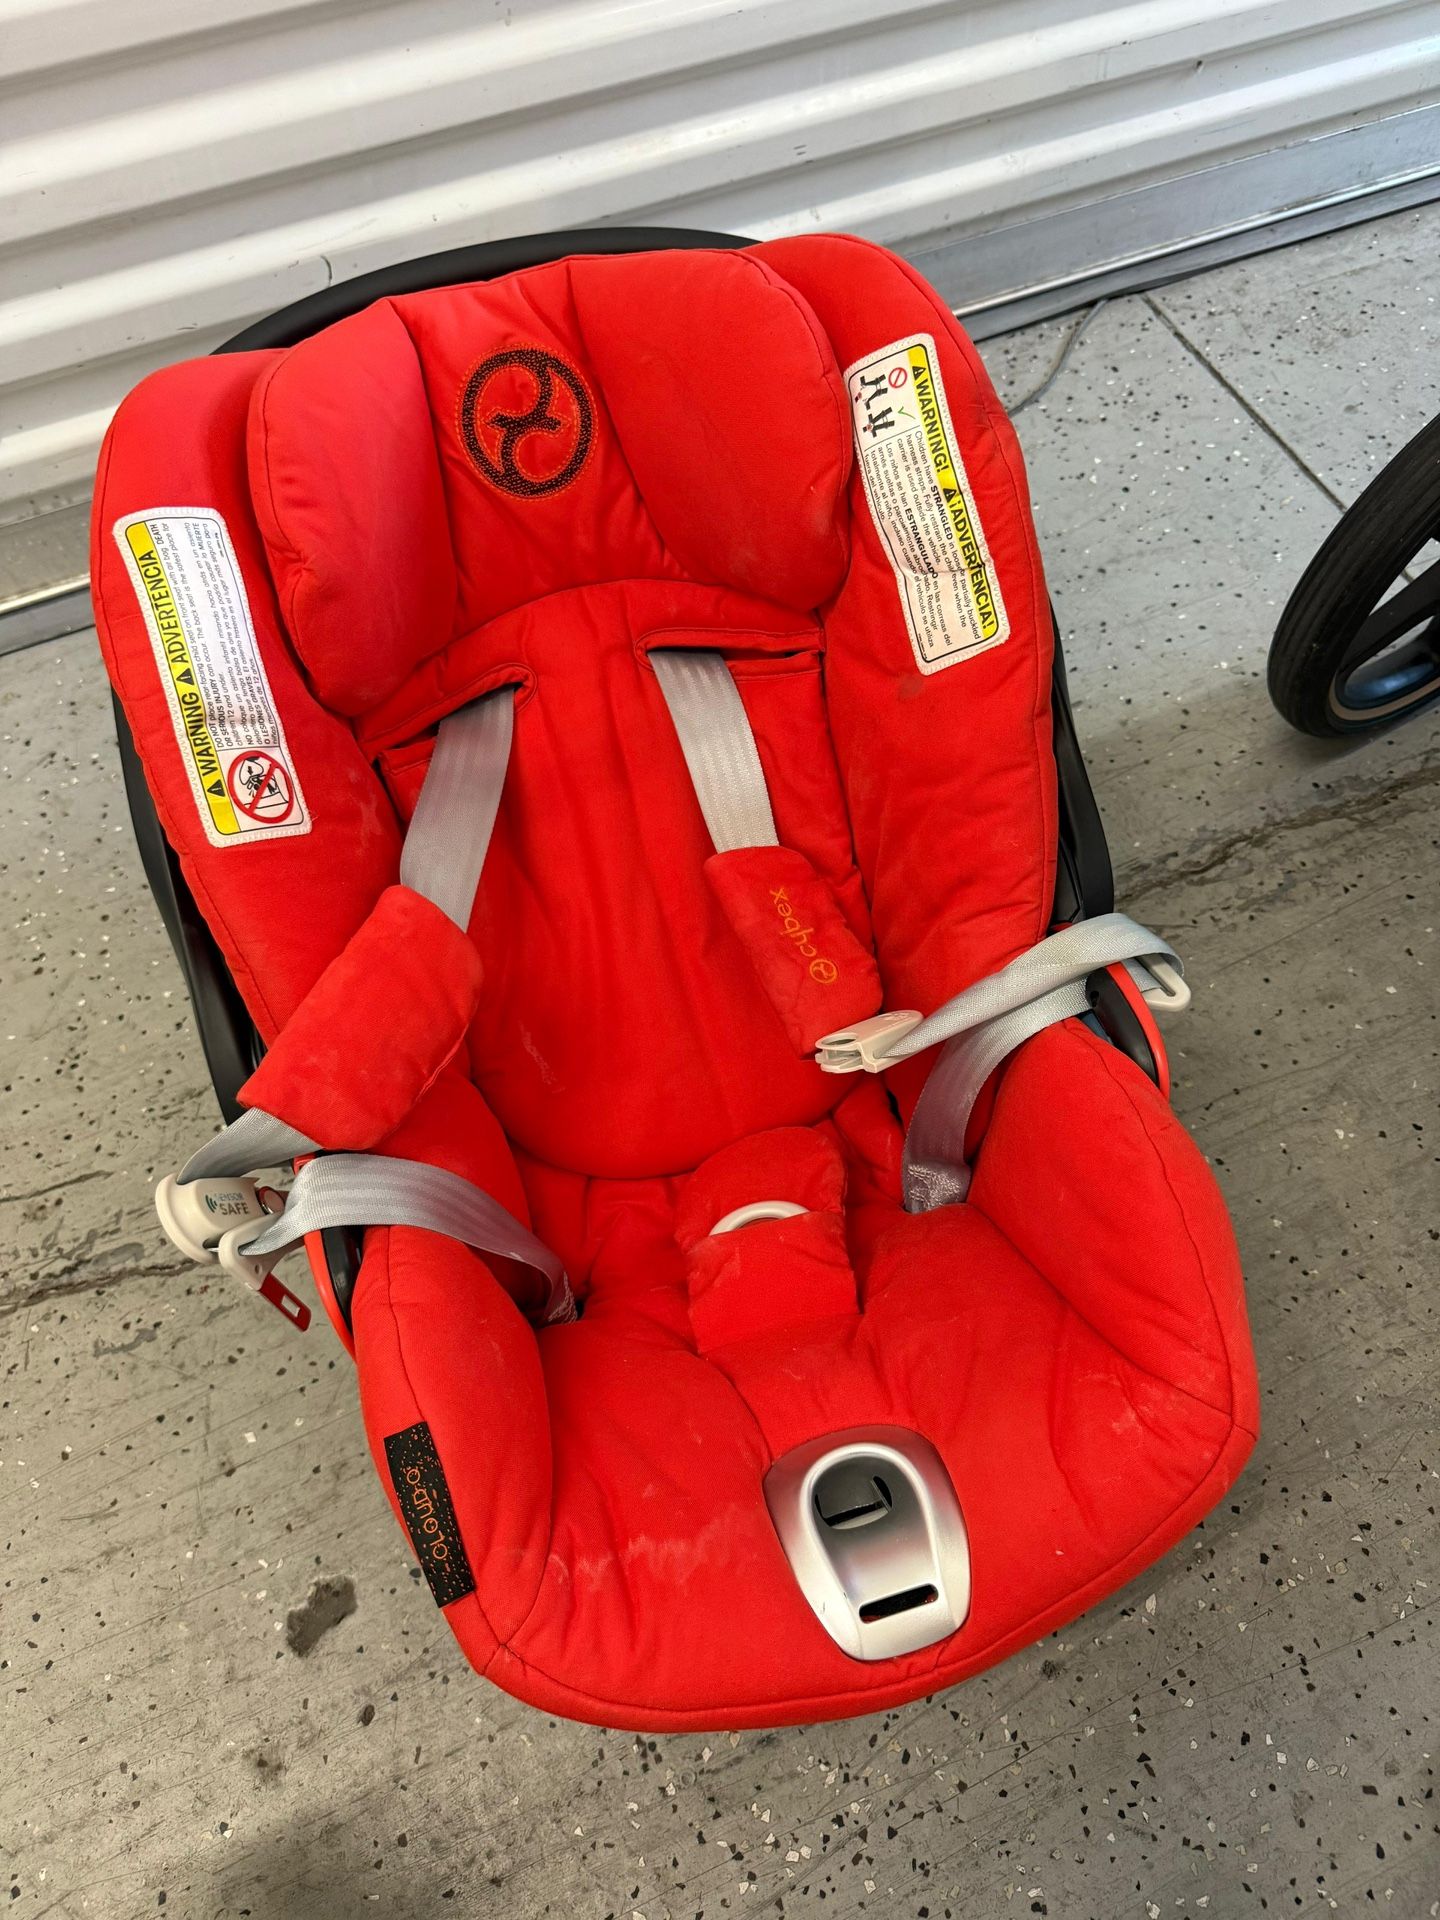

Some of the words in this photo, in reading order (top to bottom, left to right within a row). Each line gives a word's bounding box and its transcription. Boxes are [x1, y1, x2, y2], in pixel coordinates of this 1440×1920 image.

[916, 379, 949, 473] WARNING!
[897, 438, 909, 463] carrier
[864, 454, 873, 474] fuera
[905, 464, 912, 472] is
[908, 473, 918, 493] used
[913, 493, 927, 522] outside
[161, 523, 169, 532] for
[906, 434, 919, 466] harness
[915, 466, 927, 494] straps.
[923, 494, 934, 513] Fully
[930, 513, 943, 542] restrain
[940, 543, 948, 556] the
[954, 592, 963, 614] when
[923, 523, 931, 536] the
[150, 524, 164, 544] DEATH
[165, 533, 178, 551] place
[184, 522, 196, 546] asiento
[192, 523, 204, 550] MUERTE
[915, 430, 929, 464] Children
[925, 465, 934, 484] have
[931, 485, 953, 540] STRANGLED
[960, 579, 972, 609] partially
[968, 609, 980, 640] buckled
[192, 549, 199, 558] un
[206, 541, 218, 562] seguro
[870, 450, 885, 491] totalmente
[891, 520, 905, 546] incluso
[902, 547, 918, 574] cuando
[914, 575, 921, 583] el
[922, 615, 928, 625] se
[925, 626, 935, 647] utiliza
[884, 469, 896, 497] sueltas
[893, 505, 916, 553] parcialmente
[927, 594, 939, 631] Restringir
[886, 442, 894, 457] Los
[890, 458, 901, 480] niños
[897, 481, 903, 491] se
[900, 492, 909, 507] han
[905, 508, 938, 579] ESTRANGULADO
[933, 581, 938, 590] en
[936, 604, 947, 633] correas
[944, 633, 952, 646] del
[928, 536, 942, 565] vehicle.
[165, 562, 173, 570] air
[172, 552, 184, 572] safest
[205, 561, 216, 582] causar
[168, 572, 178, 585] with
[180, 573, 188, 584] the
[219, 579, 230, 595] lugar
[173, 587, 183, 601] seat
[186, 593, 195, 607] seat
[206, 590, 216, 608] hacia
[137, 550, 189, 665] ADVERTENCIA
[178, 602, 189, 618] front
[220, 607, 228, 619] que
[185, 620, 191, 628] on
[191, 610, 201, 625] back
[212, 611, 224, 638] mirando
[229, 615, 240, 638] trasero
[187, 630, 196, 644] seat
[196, 627, 204, 639] The
[226, 632, 234, 645] aire
[191, 646, 201, 662] child
[220, 641, 231, 664] infantil
[230, 647, 237, 655] de
[235, 640, 247, 664] asiento
[207, 664, 215, 676] can
[233, 658, 243, 676] bolsa
[197, 663, 212, 700] rear-facing
[217, 672, 228, 693] under.
[227, 667, 239, 691] asiento
[238, 678, 249, 697] tenga
[253, 676, 260, 684] 12
[210, 678, 222, 703] INJURY
[236, 694, 242, 702] un
[256, 686, 263, 695] de
[207, 701, 217, 721] place
[223, 695, 232, 708] and
[246, 699, 254, 711] que
[259, 696, 274, 724] menores
[217, 706, 229, 735] SERIOUS
[227, 709, 235, 717] 12
[238, 705, 249, 732] coloque
[254, 705, 269, 737] LESIONES
[180, 692, 218, 776] WARNING
[209, 722, 219, 736] NOT
[229, 721, 243, 746] children
[248, 714, 263, 745] delantero
[215, 738, 224, 748] DO
[225, 737, 233, 746] OR
[245, 735, 254, 745] NO
[219, 1202, 250, 1216] SAFE
[413, 1488, 448, 1560] CLOUD
